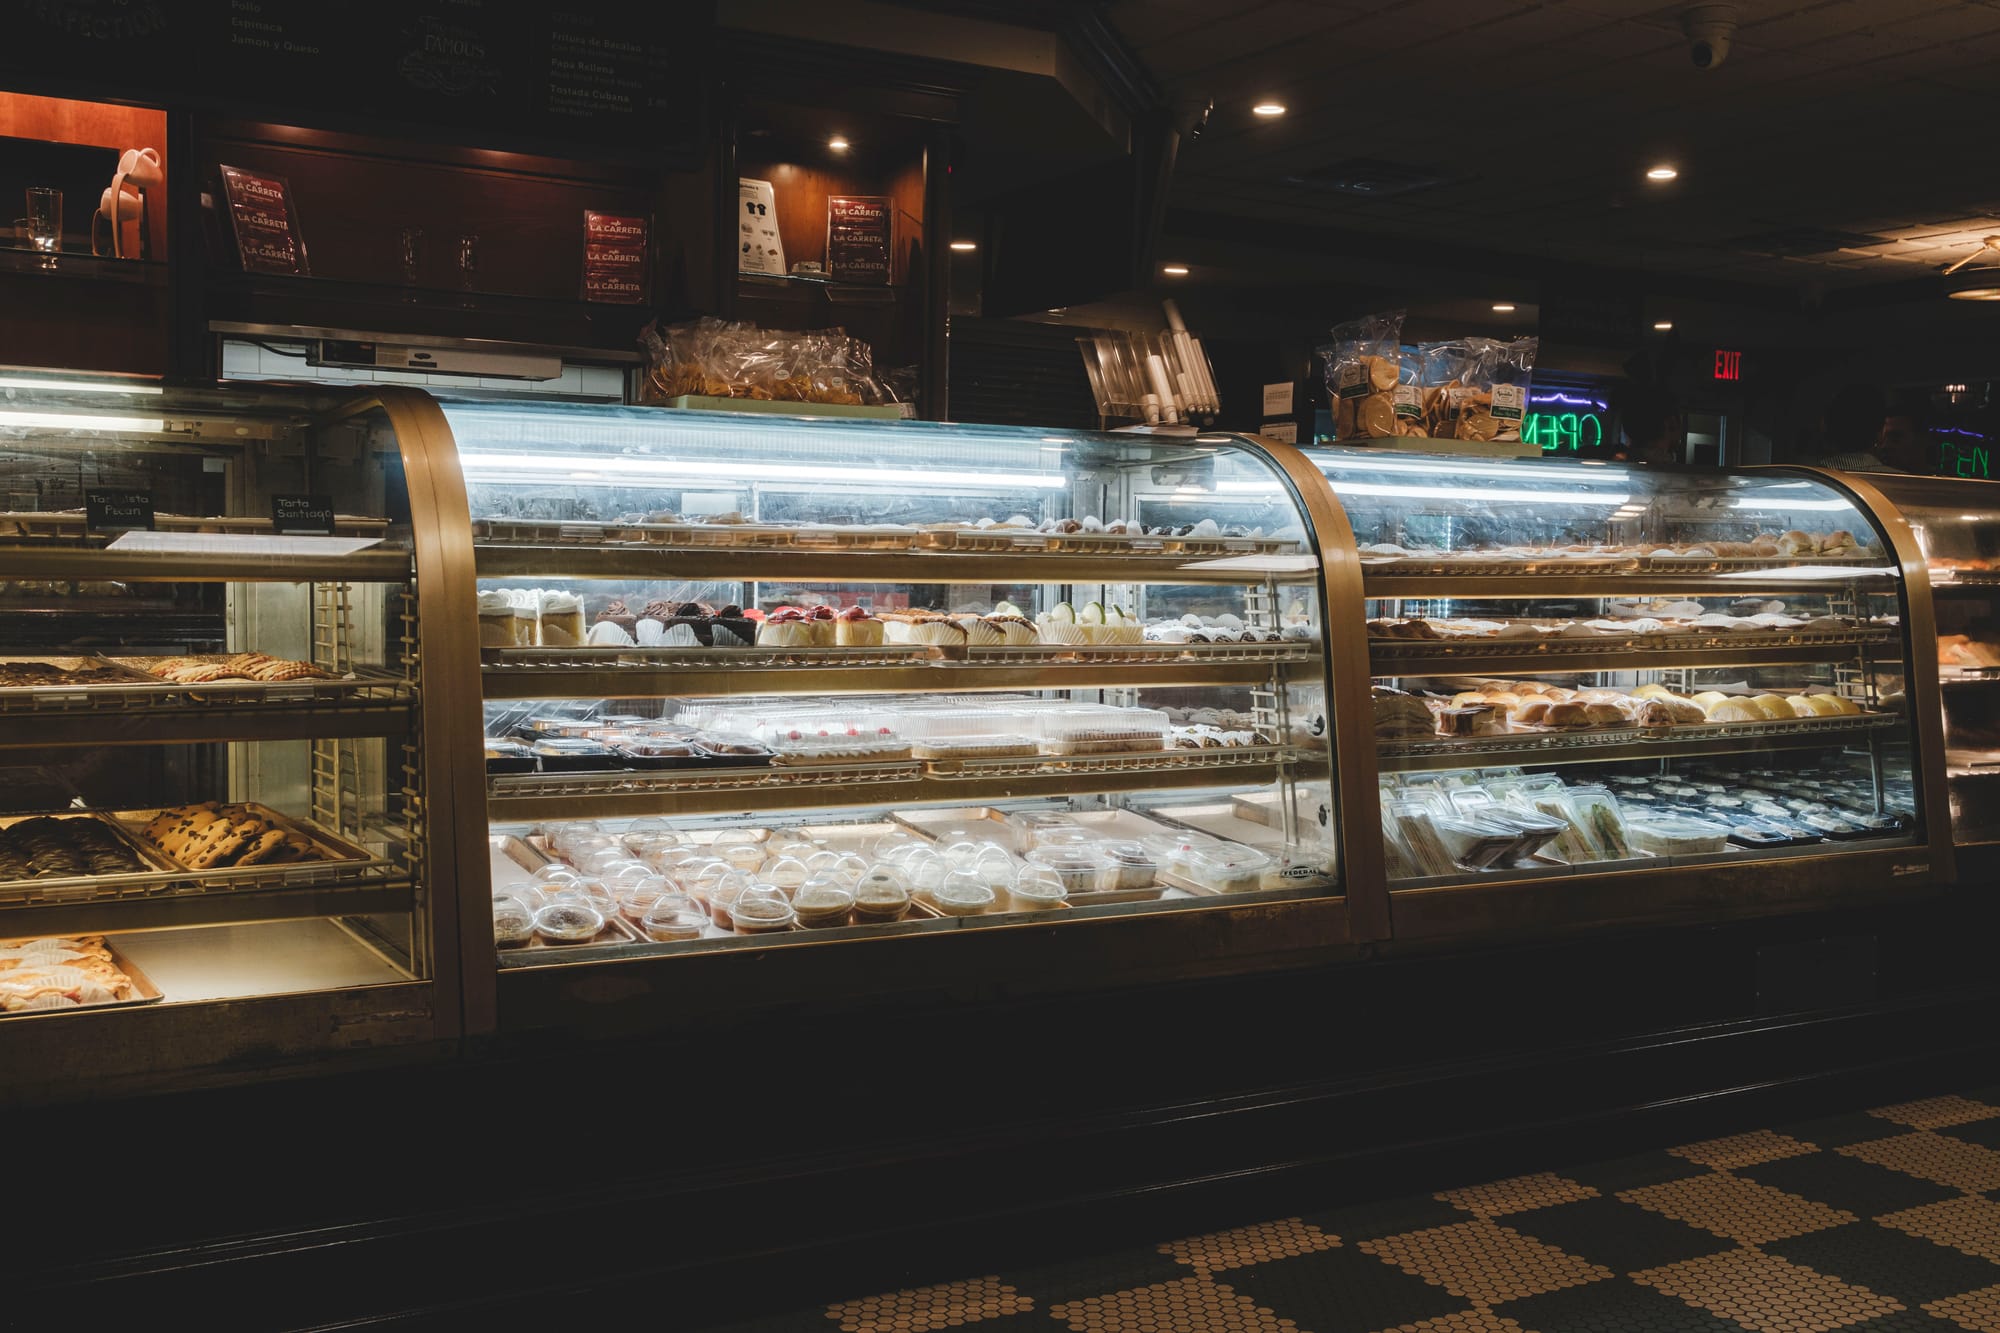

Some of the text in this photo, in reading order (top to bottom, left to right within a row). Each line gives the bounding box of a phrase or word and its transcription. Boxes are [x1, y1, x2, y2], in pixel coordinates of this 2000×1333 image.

[231, 0, 261, 13] Pollo
[231, 16, 283, 33] Espinaca
[231, 33, 320, 55] Jamon y Queso
[552, 31, 586, 46] Fritura
[588, 37, 602, 47] de
[551, 58, 615, 75] Papa Rellena
[550, 84, 630, 103] Tostada Cubana
[231, 181, 245, 191] LA
[245, 184, 283, 200] CARRETA
[835, 208, 883, 217] LA CARRETA
[237, 214, 289, 231] LA CARRETA
[604, 225, 642, 235] CARRETA
[833, 234, 883, 244] LA CARRETA
[245, 245, 296, 262] LA CARRETA
[588, 253, 641, 263] LA CARRETA
[835, 262, 885, 271] LA CARRETA
[587, 281, 641, 291] LA CARRETA
[1713, 349, 1743, 381] EXIT
[105, 504, 142, 516] Pecan
[277, 498, 310, 508] Tarta
[277, 508, 332, 523] Santiago
